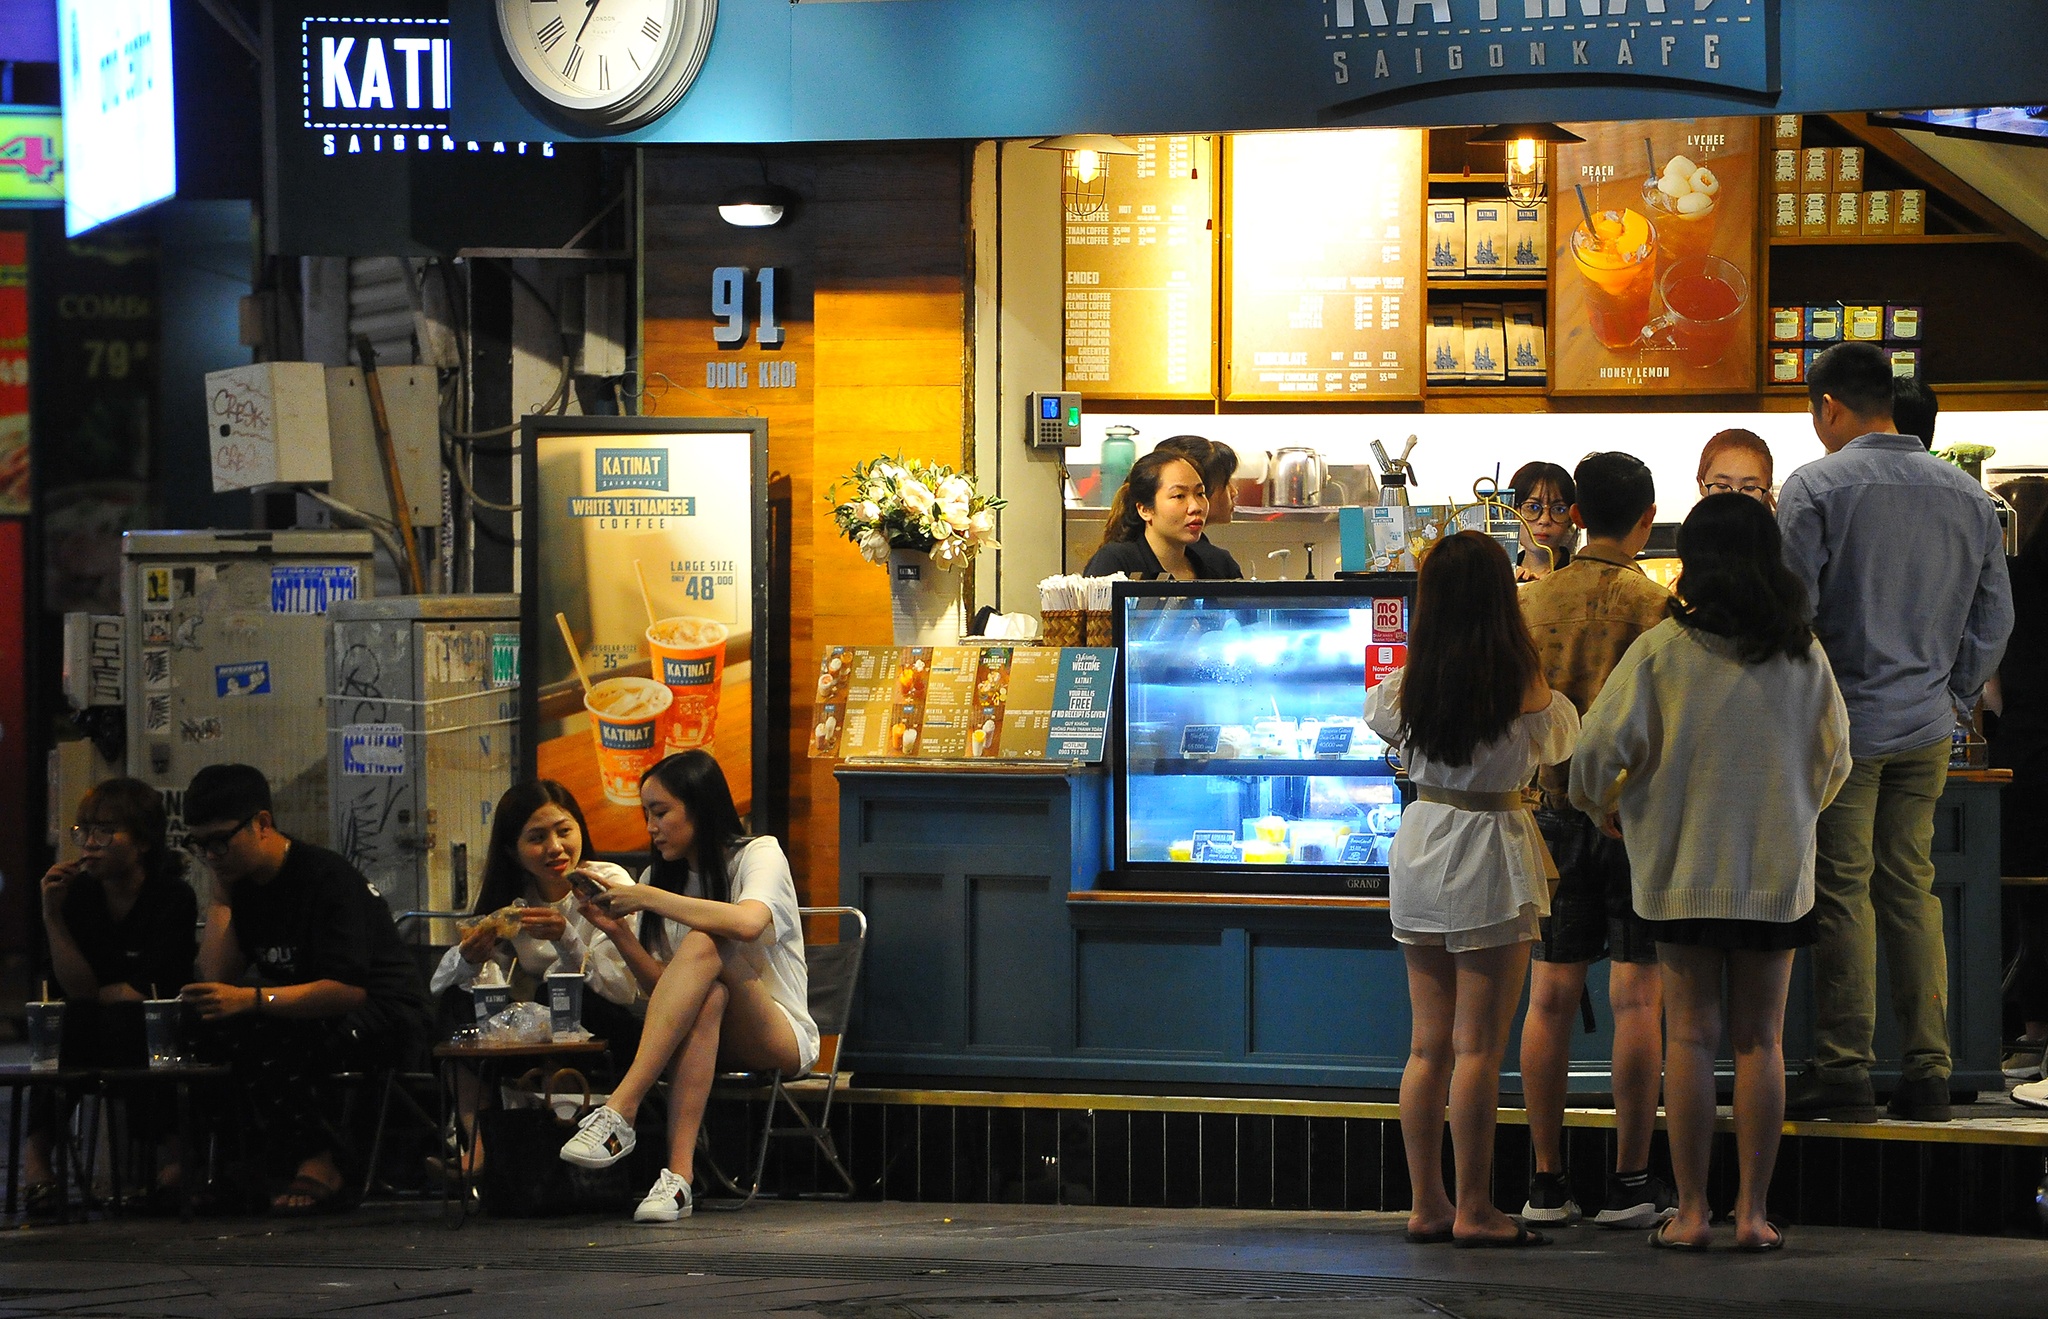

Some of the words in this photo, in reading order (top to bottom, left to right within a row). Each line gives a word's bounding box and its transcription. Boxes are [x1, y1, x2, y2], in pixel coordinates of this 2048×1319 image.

[321, 36, 451, 109] KATI
[1687, 134, 1726, 146] LYCHEE
[1581, 165, 1615, 177] PEACH
[711, 266, 785, 344] 91
[1599, 367, 1633, 378] HONEY
[1636, 367, 1670, 378] LEMON
[602, 456, 662, 476] KATINAT
[571, 498, 612, 516] WHITE
[613, 498, 690, 516] VIETNAMESE
[599, 518, 665, 529] COFFEE
[670, 560, 706, 572] LARGE
[710, 560, 734, 572] SIZE
[666, 661, 712, 678] KATINAT
[1072, 661, 1102, 672] WELCOME
[1070, 697, 1092, 710] FREE
[602, 725, 651, 743] KATINAT
[1346, 878, 1381, 889] GRAND
